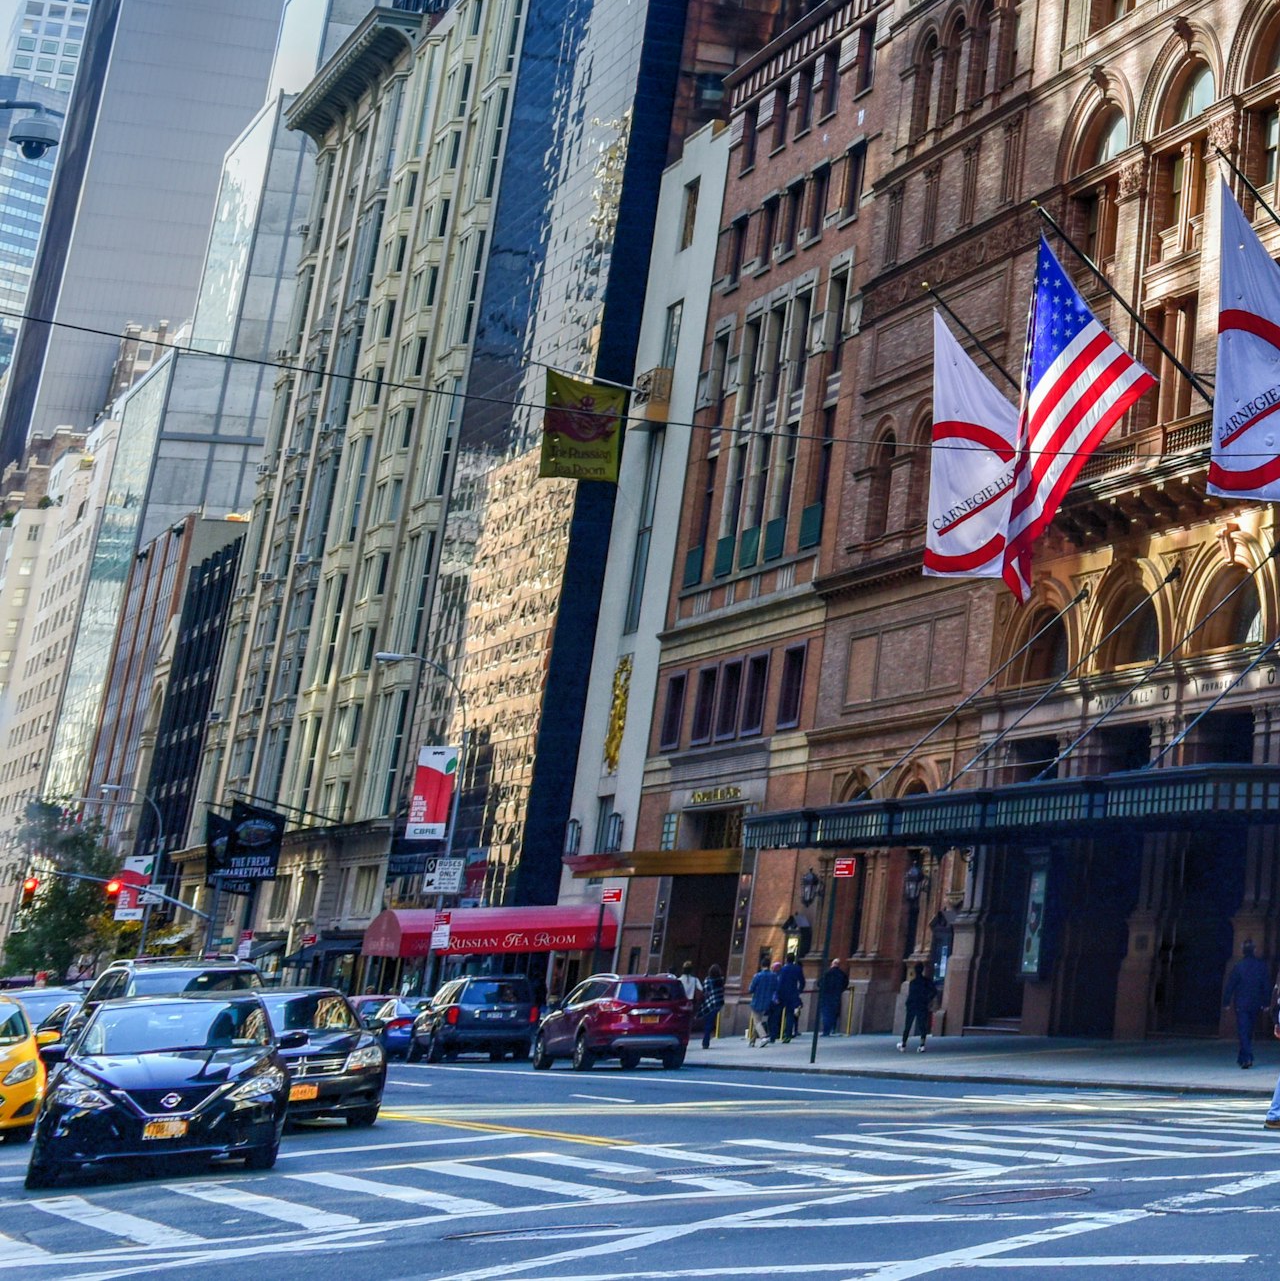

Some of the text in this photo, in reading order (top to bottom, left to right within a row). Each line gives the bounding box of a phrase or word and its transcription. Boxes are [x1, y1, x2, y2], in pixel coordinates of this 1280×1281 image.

[1218, 388, 1280, 440] CARNEGIE
[932, 467, 1016, 530] CARNEGIE HA
[231, 856, 270, 867] THE FRESH
